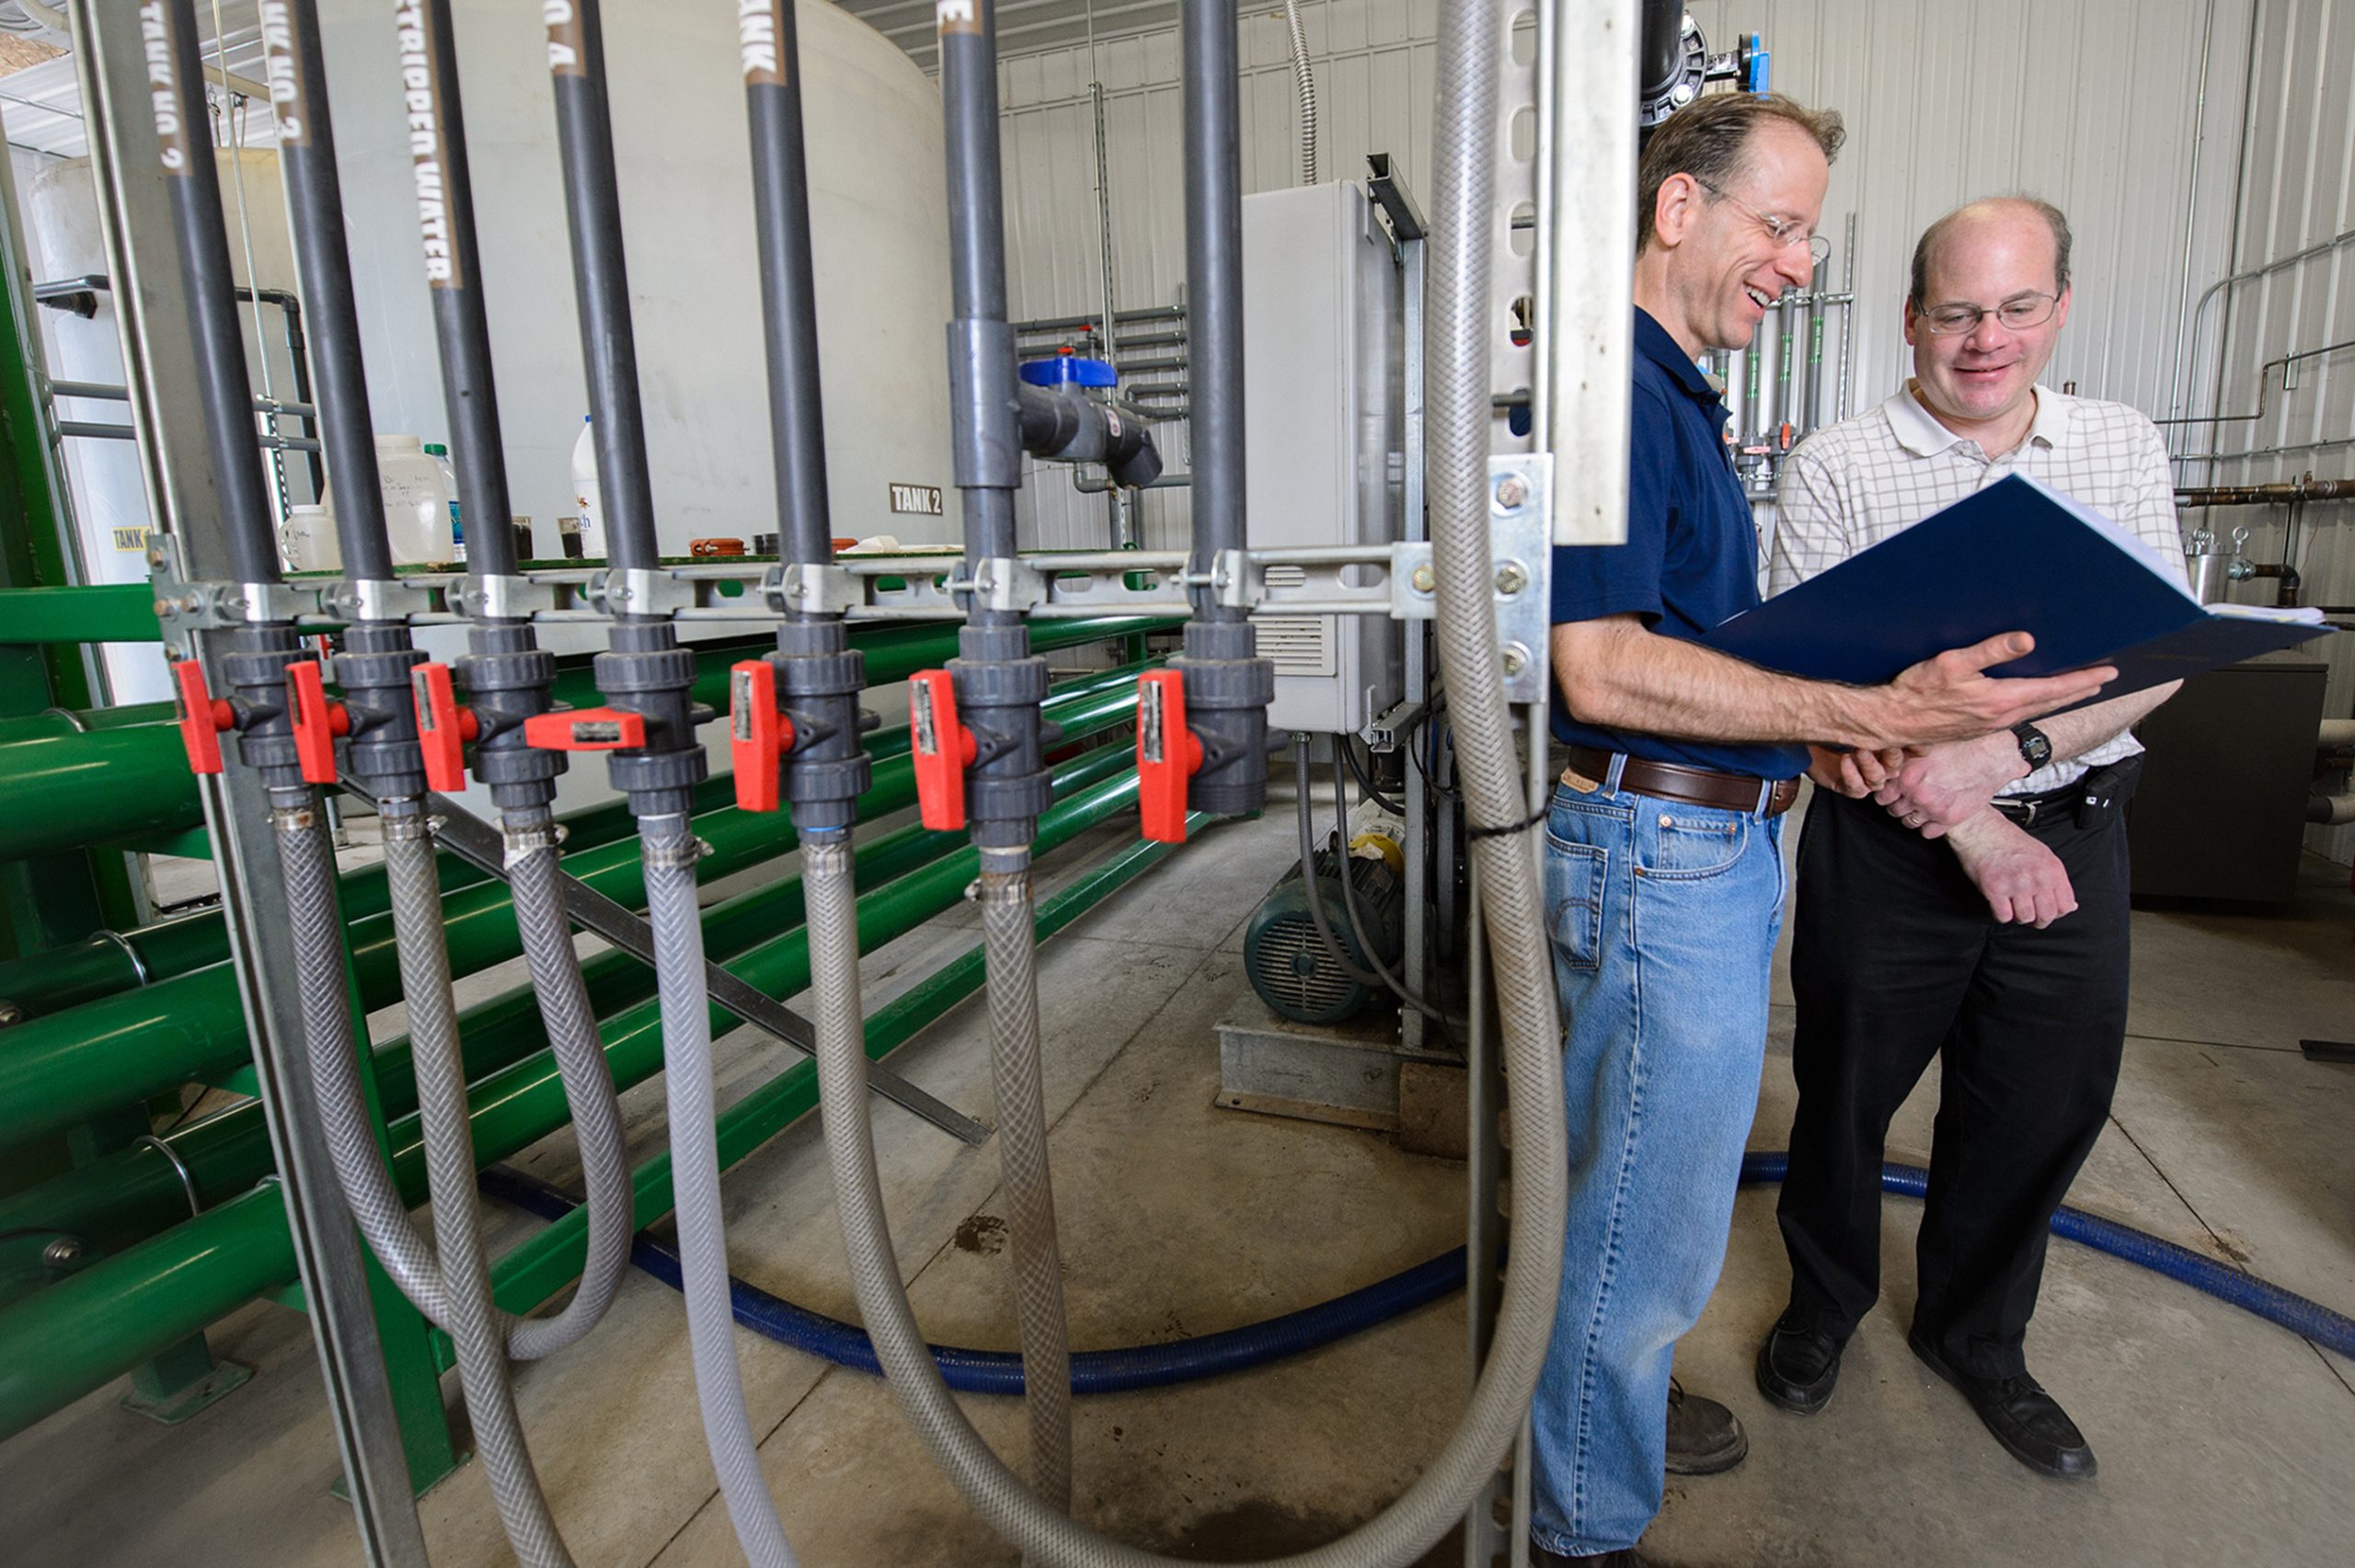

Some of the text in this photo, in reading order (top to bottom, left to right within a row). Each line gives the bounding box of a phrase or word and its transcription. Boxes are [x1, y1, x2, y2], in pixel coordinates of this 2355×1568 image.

[140, 2, 174, 86] TANK
[414, 162, 452, 280] WATER
[891, 486, 942, 513] TANK 2
[112, 529, 144, 549] TANK
